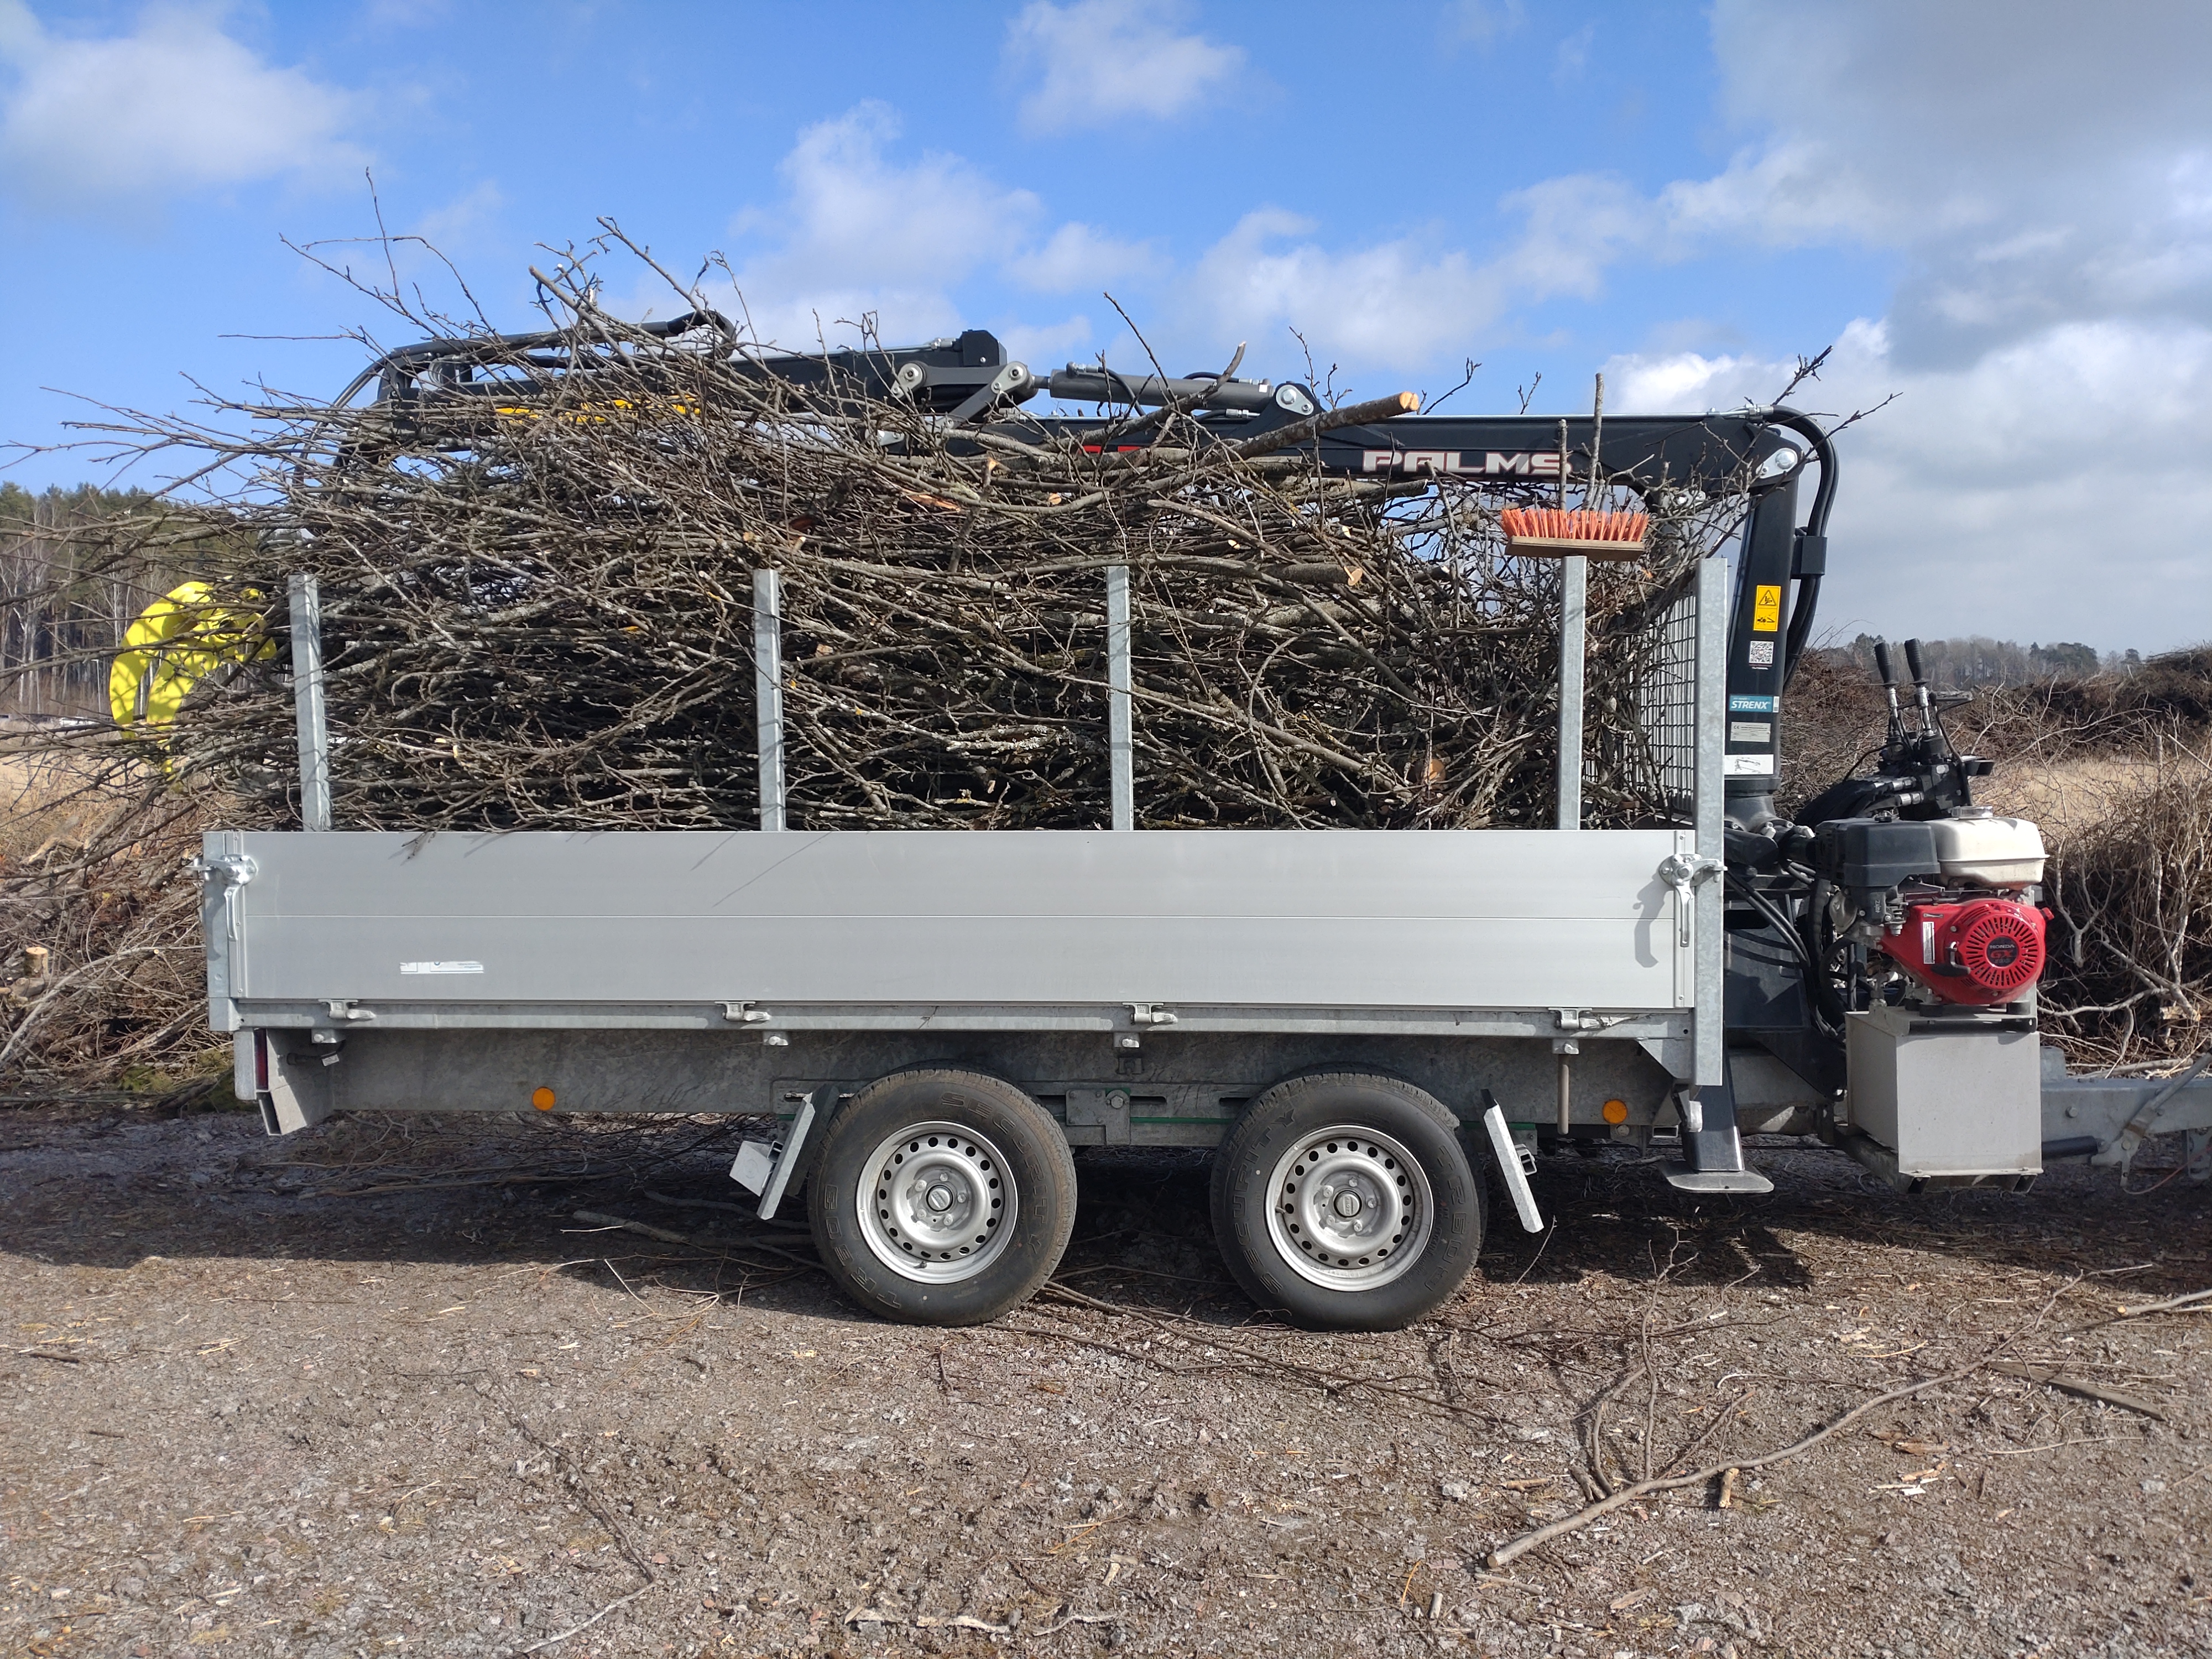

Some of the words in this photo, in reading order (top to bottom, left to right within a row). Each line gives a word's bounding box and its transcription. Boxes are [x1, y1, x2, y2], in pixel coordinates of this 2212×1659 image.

[1363, 450, 1572, 475] PALMS
[1731, 700, 1767, 709] STRENX
[1991, 950, 2013, 959] GX
[941, 1092, 1048, 1254] SECURITY
[1234, 1108, 1295, 1295] SECURITY
